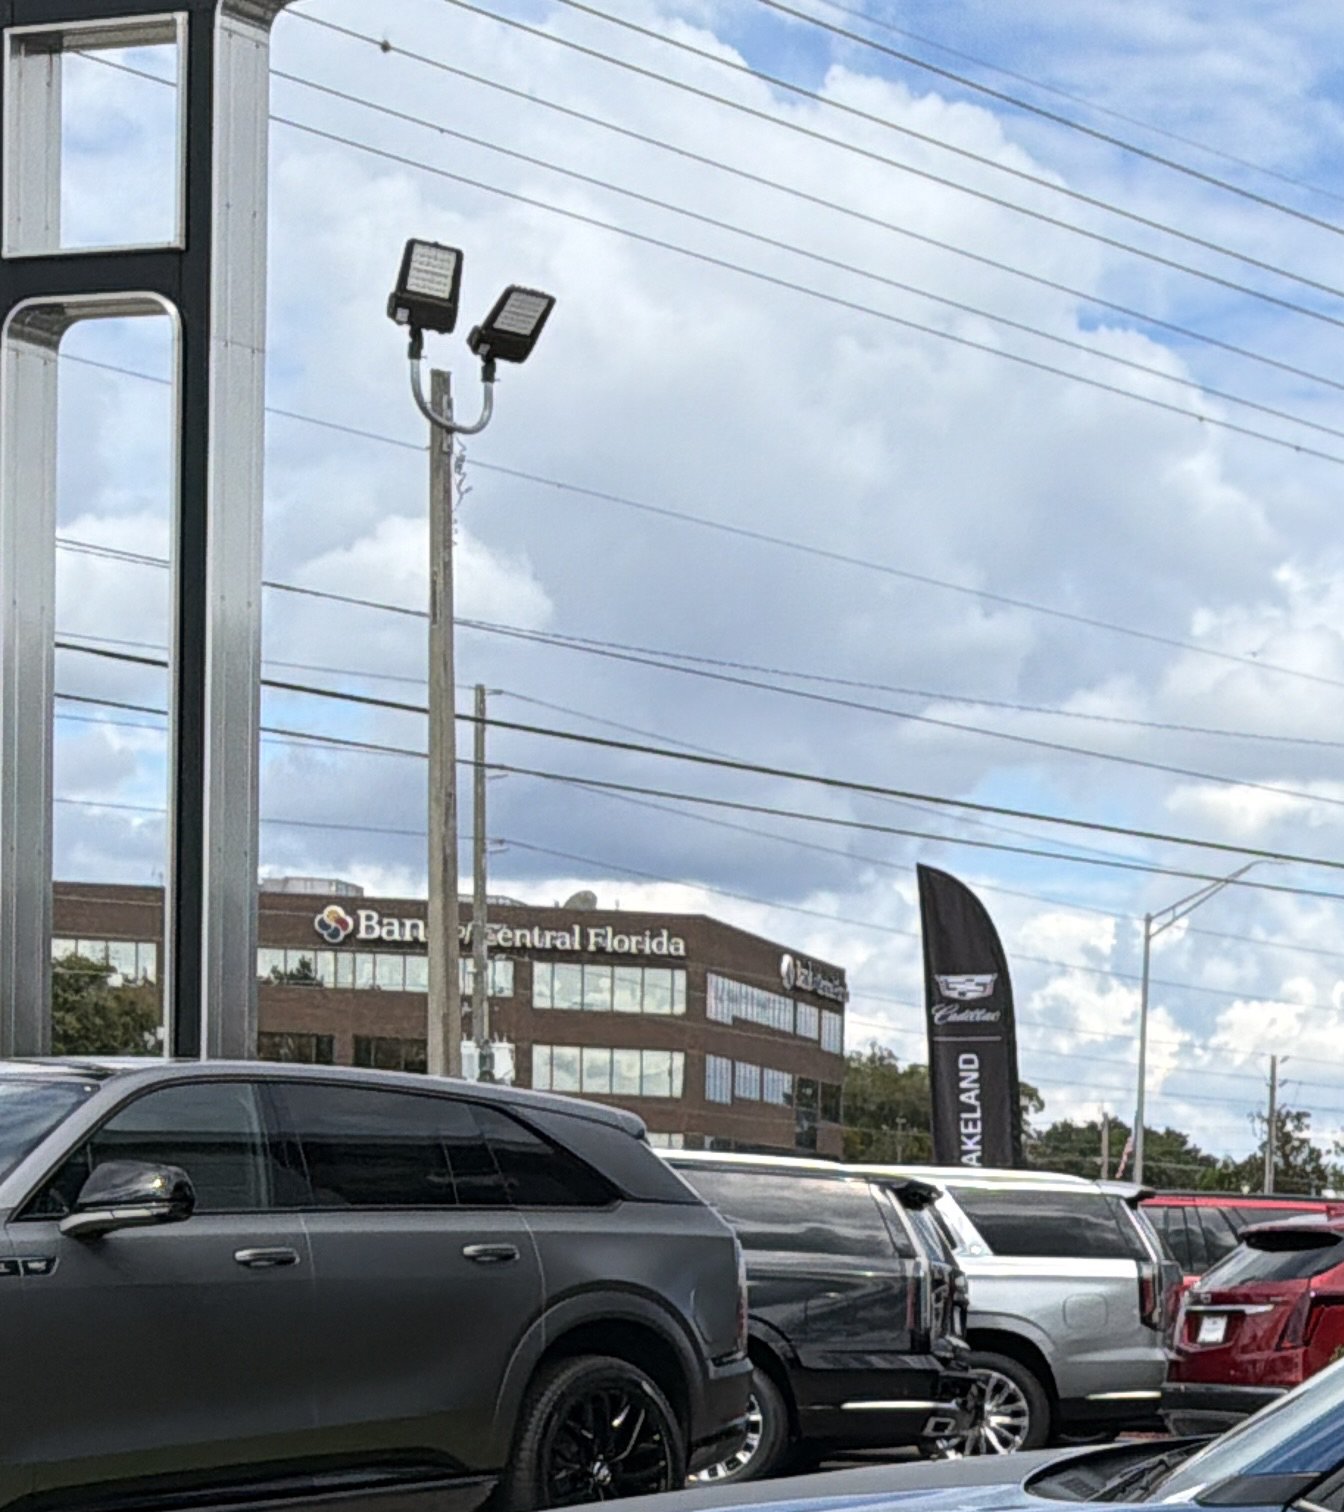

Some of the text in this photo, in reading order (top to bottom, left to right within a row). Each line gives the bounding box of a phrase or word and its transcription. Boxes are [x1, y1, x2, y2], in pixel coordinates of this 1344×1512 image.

[356, 909, 428, 942] Ban
[587, 926, 686, 957] Florida
[931, 1003, 1001, 1025] Cadillac
[958, 1053, 983, 1167] AKELAND
